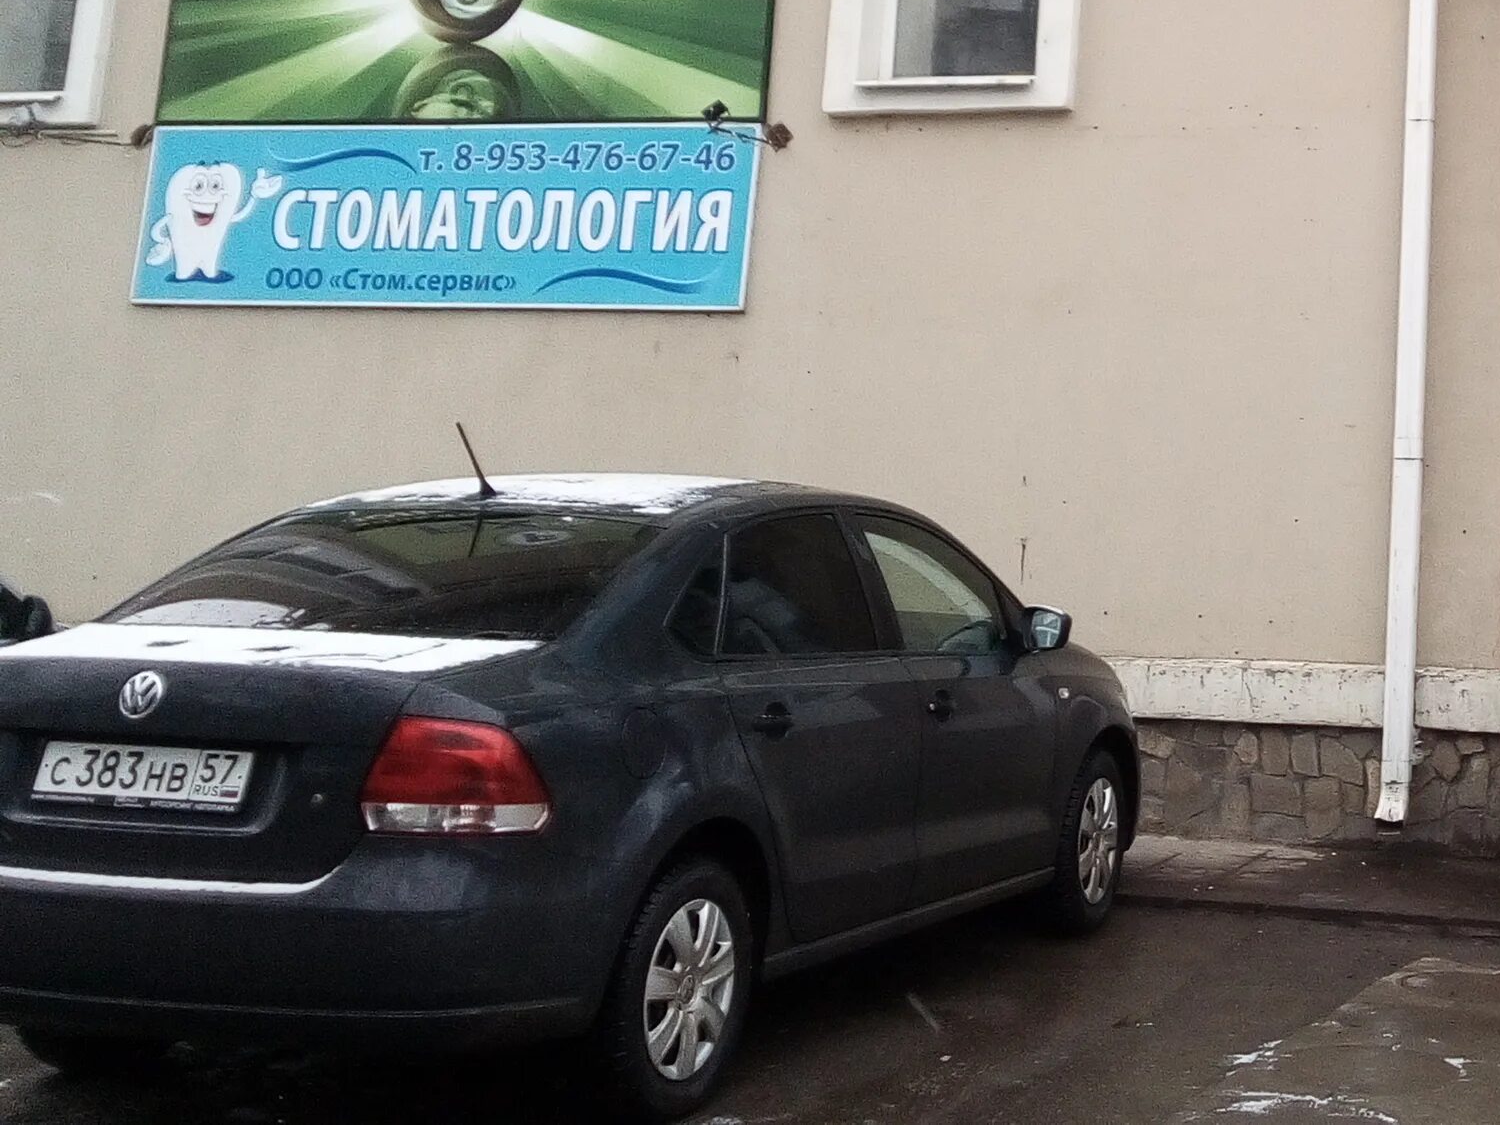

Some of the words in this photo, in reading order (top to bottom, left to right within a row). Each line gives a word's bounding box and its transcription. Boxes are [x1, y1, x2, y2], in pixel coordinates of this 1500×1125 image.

[453, 141, 737, 173] 8-953-476-67-46
[272, 188, 733, 253] СТОМАТОЛОГИЯ
[266, 268, 324, 292] ООО
[328, 266, 517, 297] «Стом.сервис»
[199, 753, 239, 785] 57
[192, 784, 219, 797] RUS
